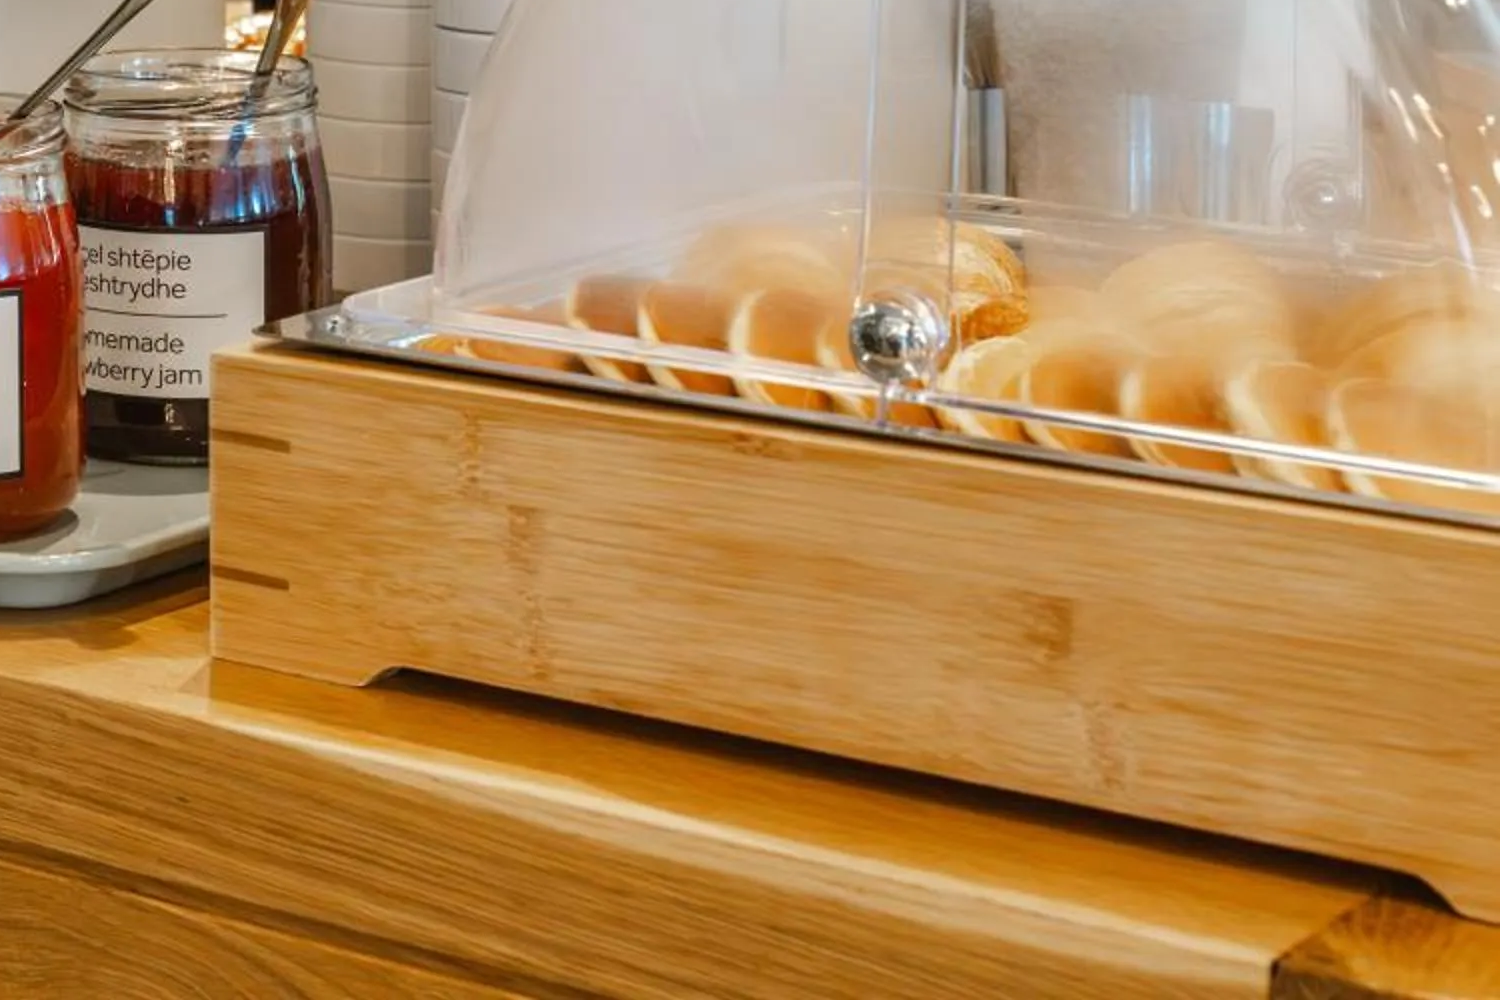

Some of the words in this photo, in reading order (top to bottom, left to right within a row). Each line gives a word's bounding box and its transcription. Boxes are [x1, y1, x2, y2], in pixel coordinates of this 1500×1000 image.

[106, 247, 192, 275] shtëpie
[83, 272, 187, 304] eshtrydhe
[83, 328, 186, 355] memade
[84, 356, 155, 390] wberry
[155, 363, 204, 390] jam
